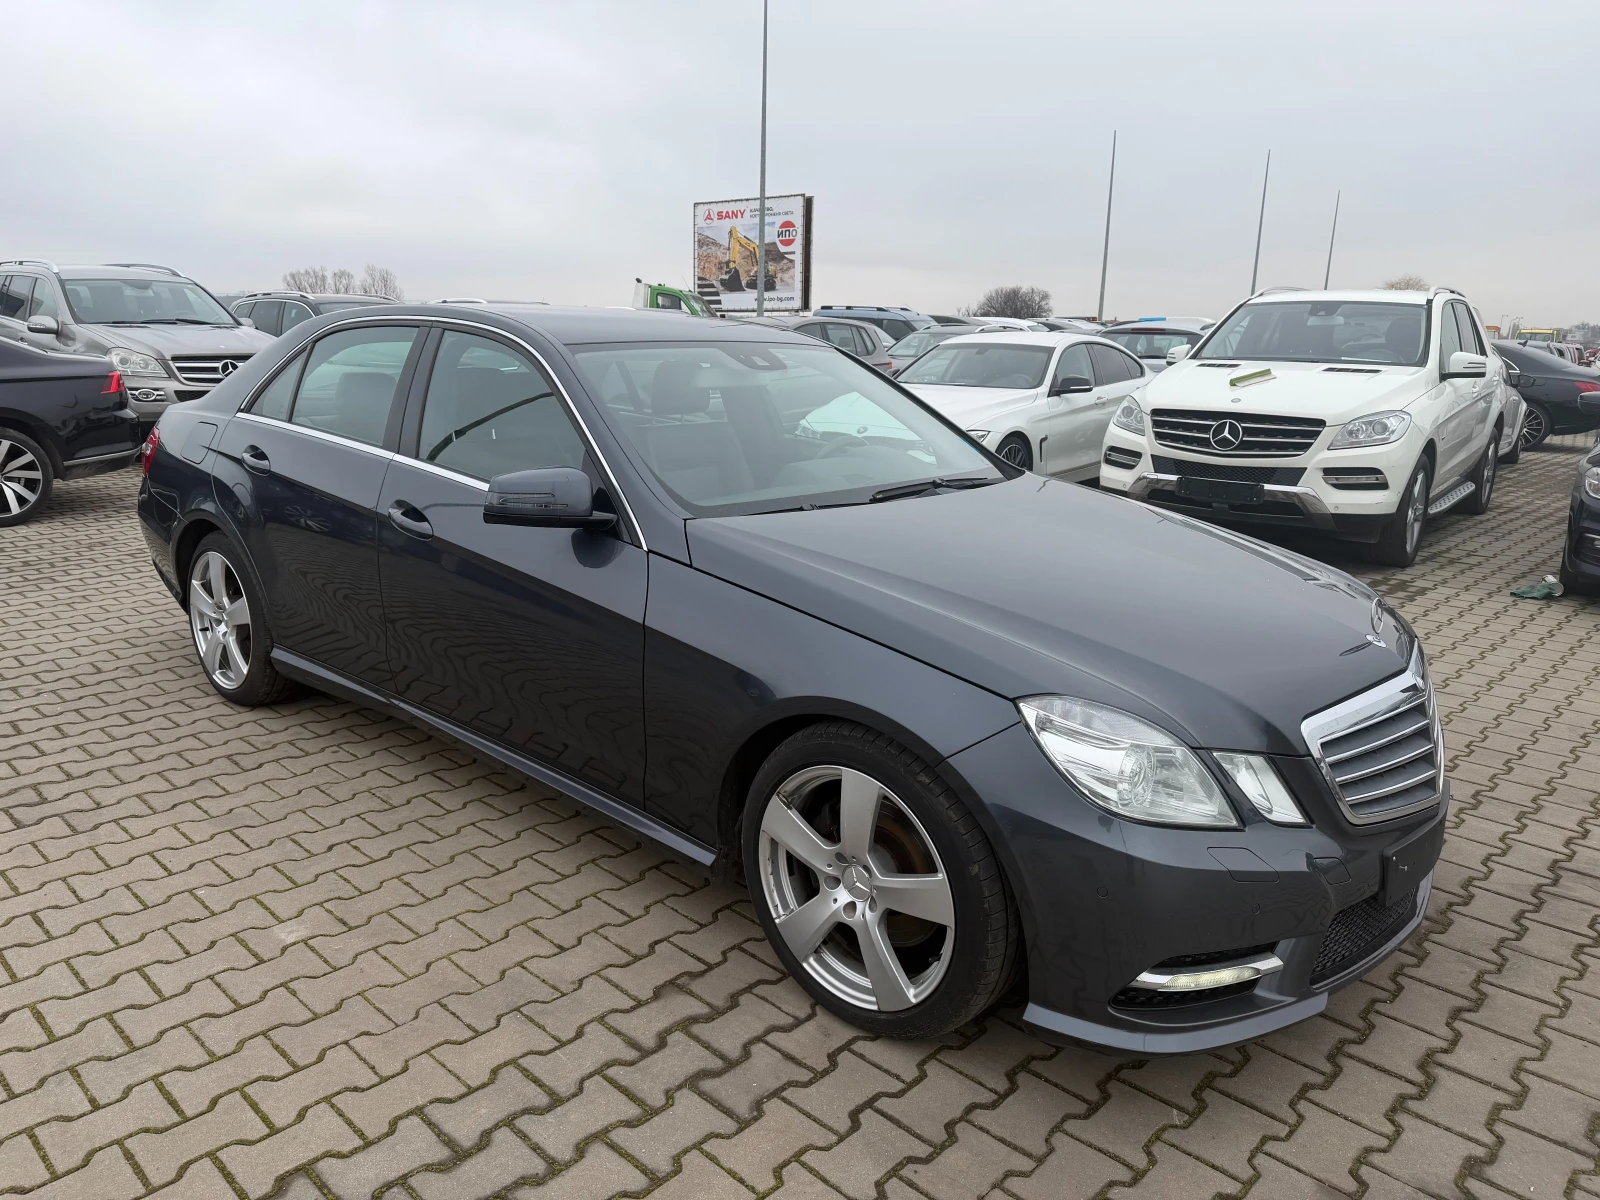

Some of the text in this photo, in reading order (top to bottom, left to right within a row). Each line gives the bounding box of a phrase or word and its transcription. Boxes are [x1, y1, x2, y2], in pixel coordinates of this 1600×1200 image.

[716, 209, 746, 221] SANY
[777, 229, 798, 239] ИПО
[754, 295, 795, 303] ww.ipo-bg.com
